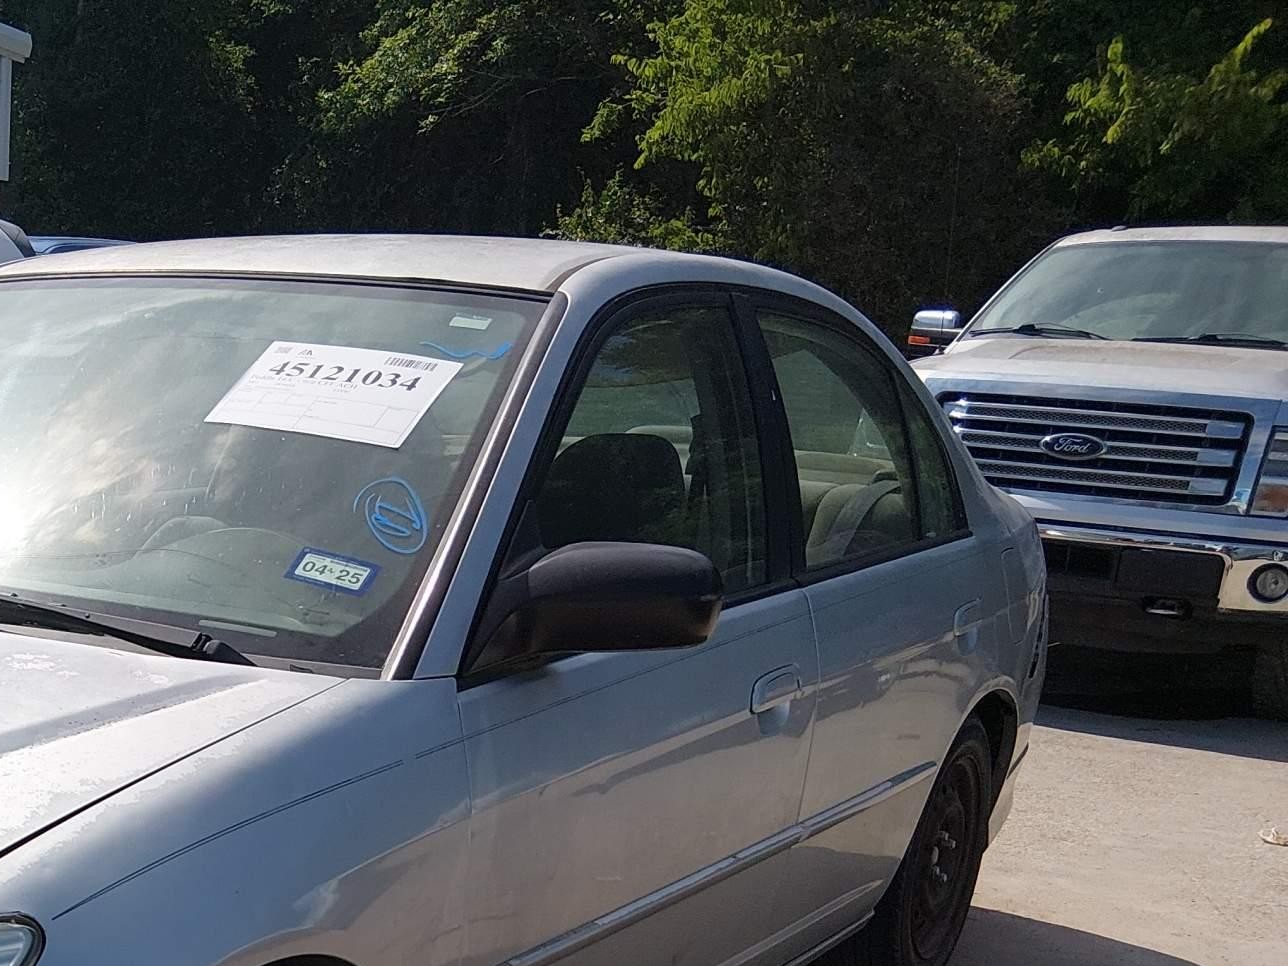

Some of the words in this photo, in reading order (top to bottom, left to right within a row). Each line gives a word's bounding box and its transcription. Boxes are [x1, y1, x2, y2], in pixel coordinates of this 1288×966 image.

[269, 360, 422, 392] 45121034
[1054, 437, 1091, 453] Ford
[302, 560, 328, 575] 04
[335, 569, 364, 584] 25
